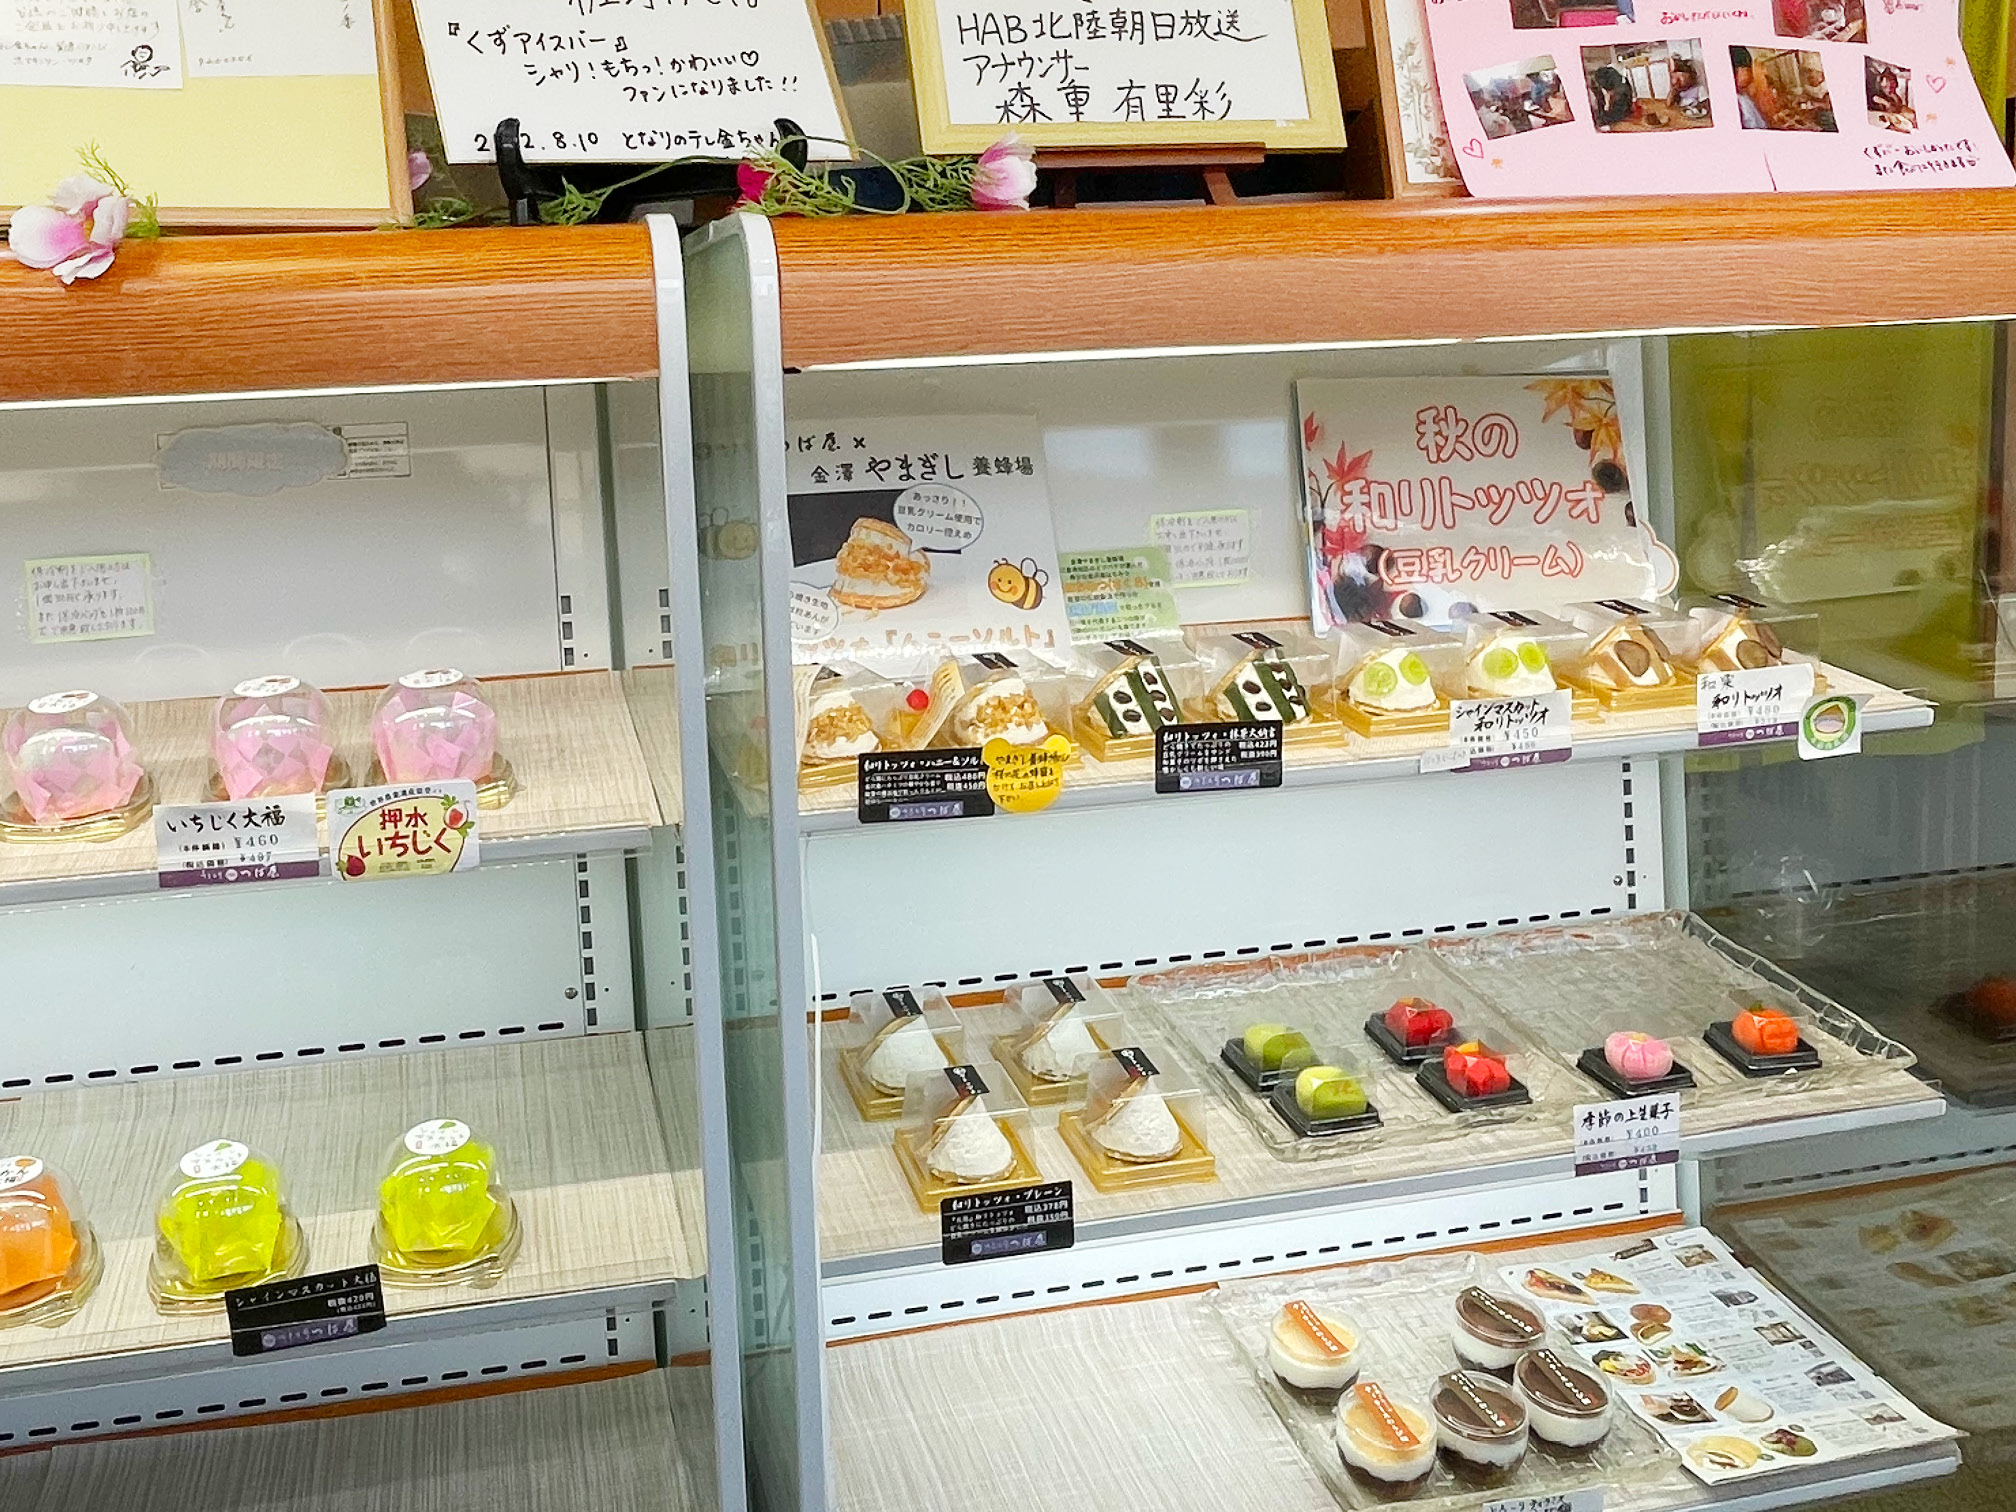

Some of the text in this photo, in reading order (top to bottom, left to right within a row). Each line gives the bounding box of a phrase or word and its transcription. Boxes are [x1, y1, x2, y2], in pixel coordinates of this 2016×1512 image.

[964, 50, 1089, 85] アナウンサー
[1415, 404, 1519, 464] 秋の
[166, 804, 286, 833] いちじく大福
[379, 805, 429, 831] 押水
[357, 826, 452, 859] いちじく
